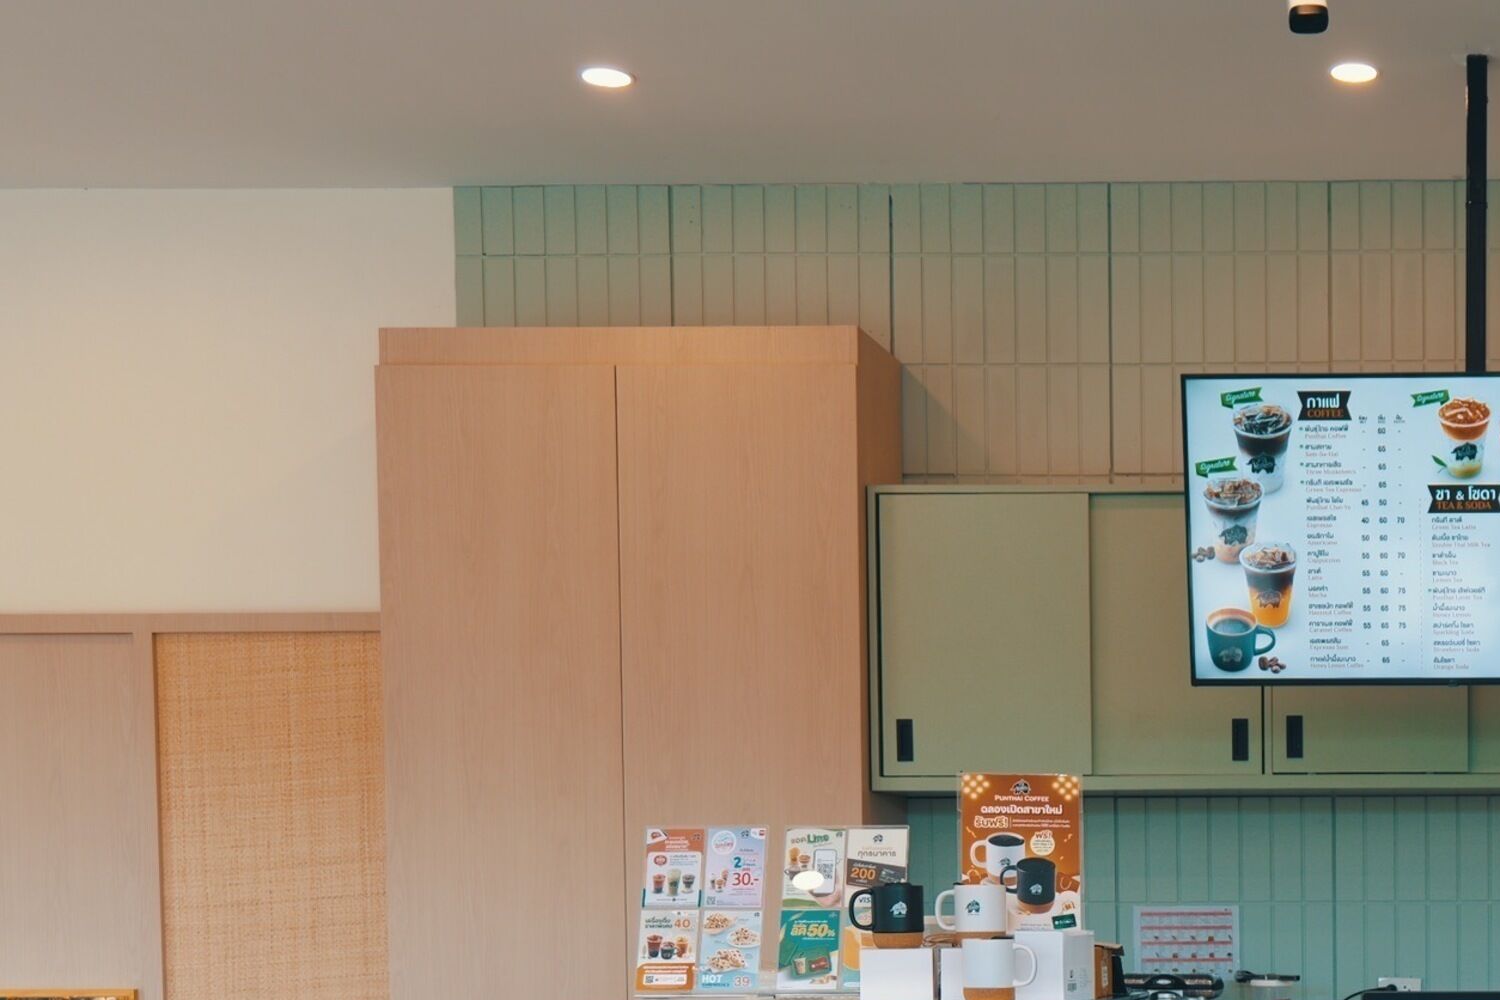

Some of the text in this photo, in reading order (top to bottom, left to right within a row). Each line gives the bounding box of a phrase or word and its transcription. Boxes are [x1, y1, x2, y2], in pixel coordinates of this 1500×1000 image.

[1306, 393, 1340, 409] กาแฟ
[1435, 486, 1496, 500] ชา & โซดา
[734, 857, 742, 868] 2
[851, 867, 875, 880] 200
